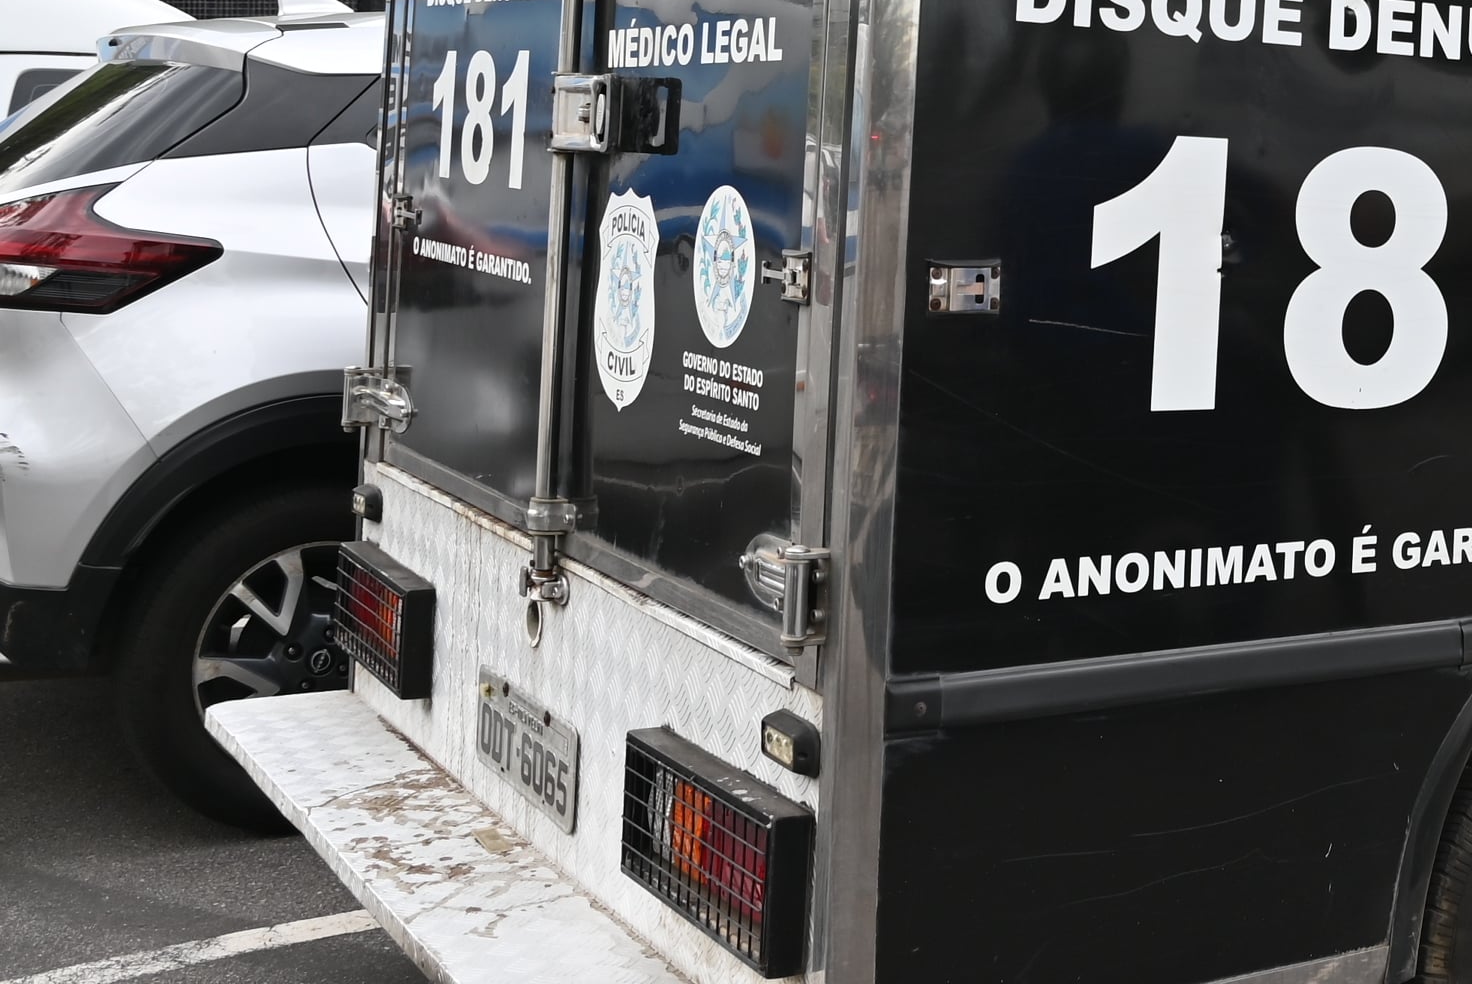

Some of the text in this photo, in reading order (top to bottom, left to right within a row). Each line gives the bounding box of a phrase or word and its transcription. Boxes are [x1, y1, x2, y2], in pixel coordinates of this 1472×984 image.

[608, 16, 783, 68] MÉDICO LEGAL
[432, 49, 530, 190] 181
[611, 209, 646, 242] POLÍCIA
[413, 236, 532, 285] O ANONIMATO É GARANTIDO.
[607, 351, 636, 377] CIVIL
[683, 351, 764, 388] GOVERNO DO ESTADO
[616, 389, 624, 401] ES
[684, 374, 760, 411] DO ESPÍRITO SANTO
[984, 562, 1022, 604] O
[1038, 538, 1336, 600] ANONIMATO
[1351, 524, 1377, 573] É
